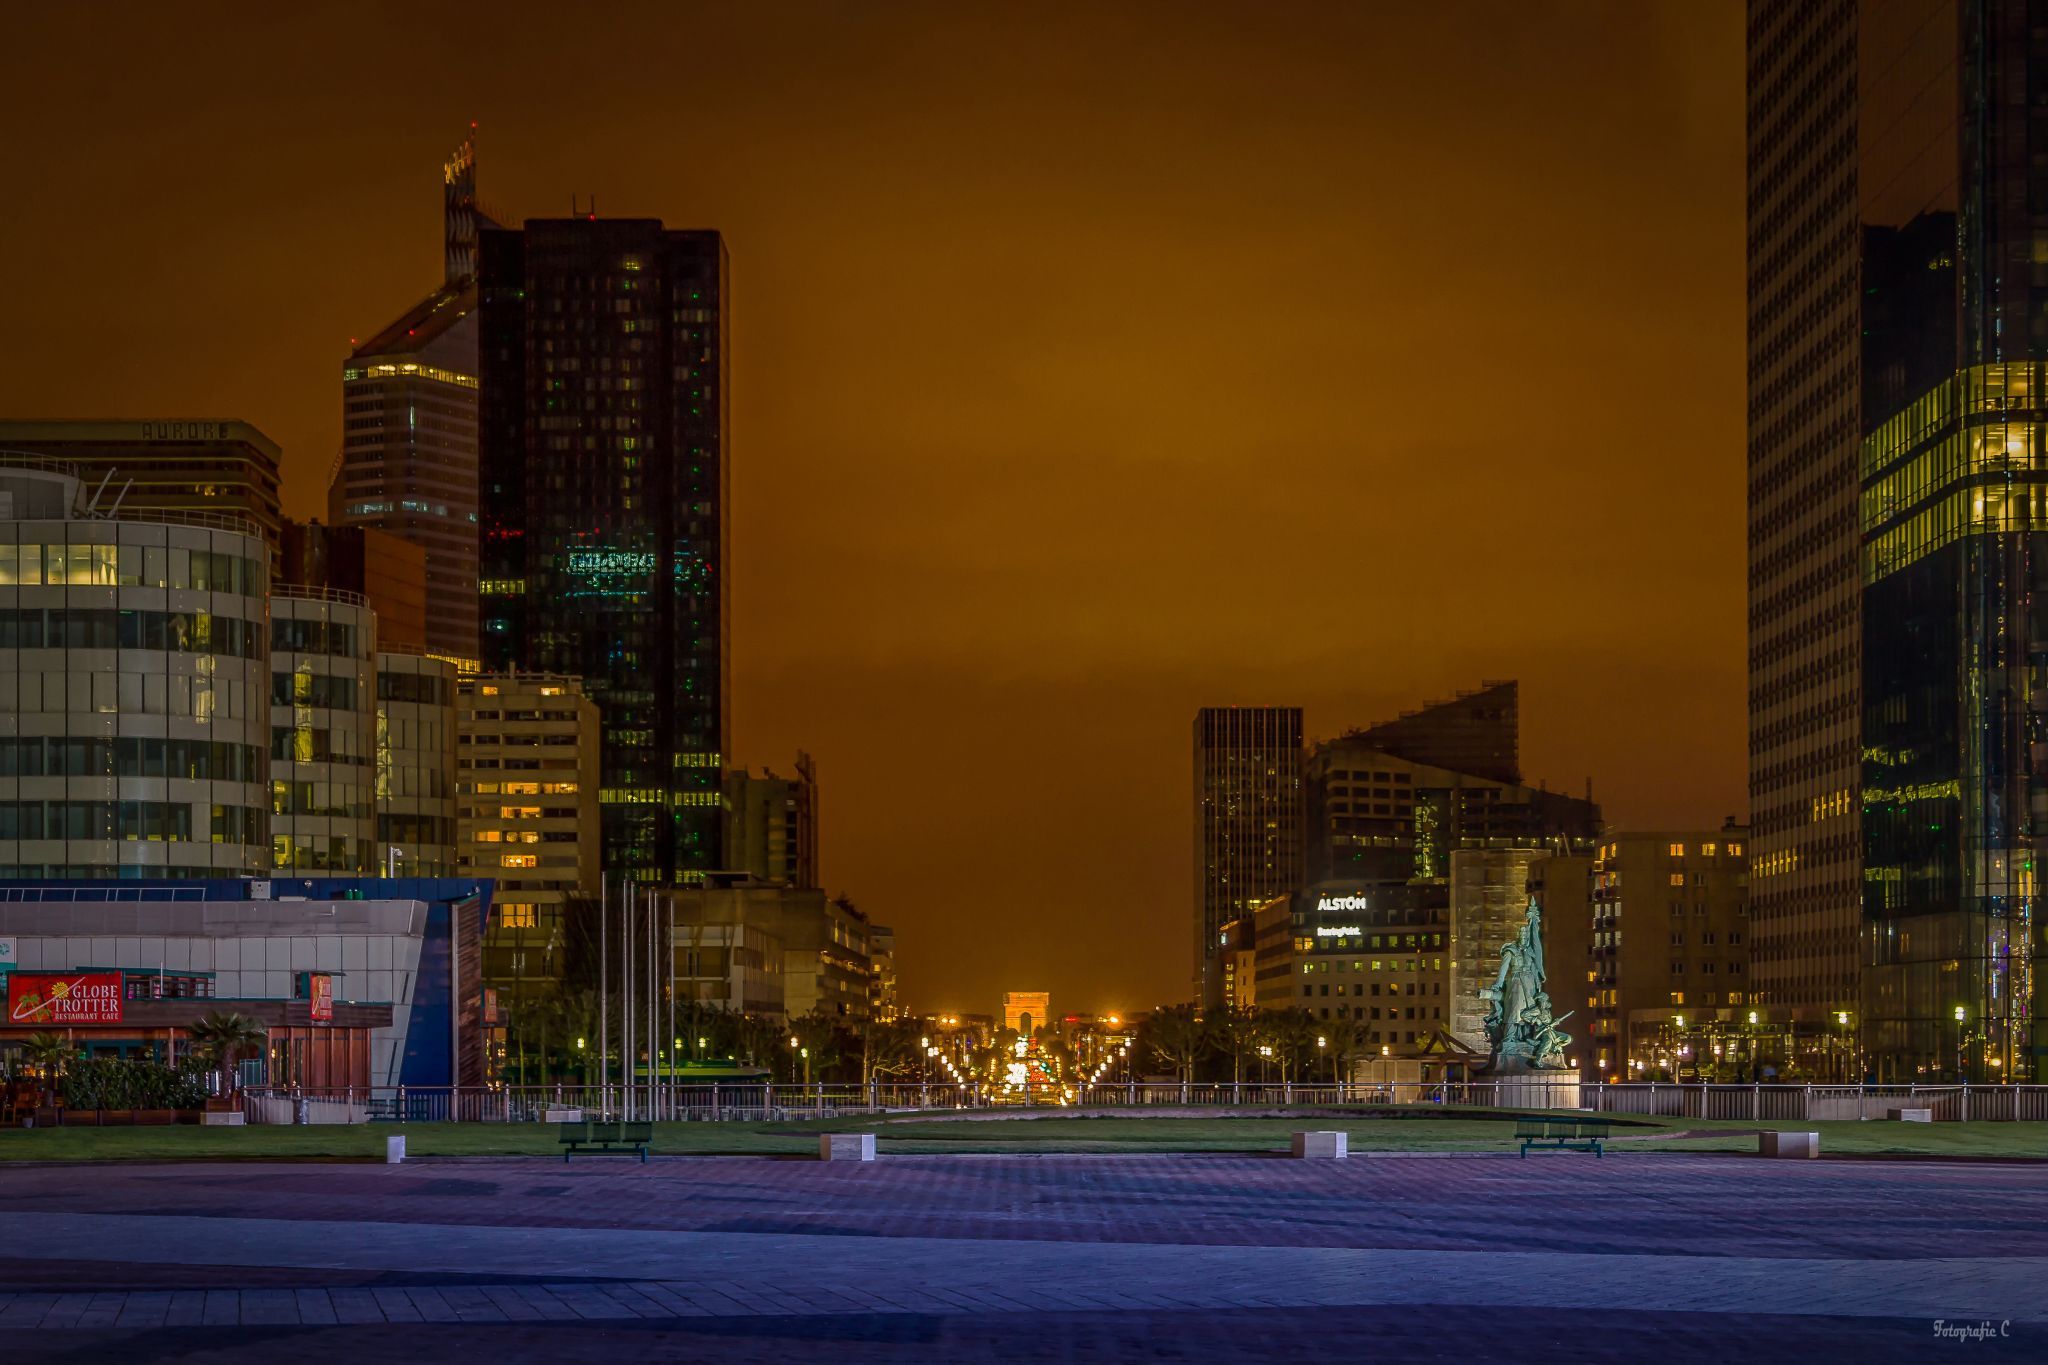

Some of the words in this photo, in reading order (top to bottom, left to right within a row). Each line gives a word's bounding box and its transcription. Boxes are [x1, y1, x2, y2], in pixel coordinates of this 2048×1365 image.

[142, 421, 229, 439] AURORE
[1317, 896, 1366, 911] ALSTOM
[72, 985, 118, 999] GLOBE
[55, 999, 119, 1012] TROTTER
[55, 1012, 98, 1020] RESTAURANT
